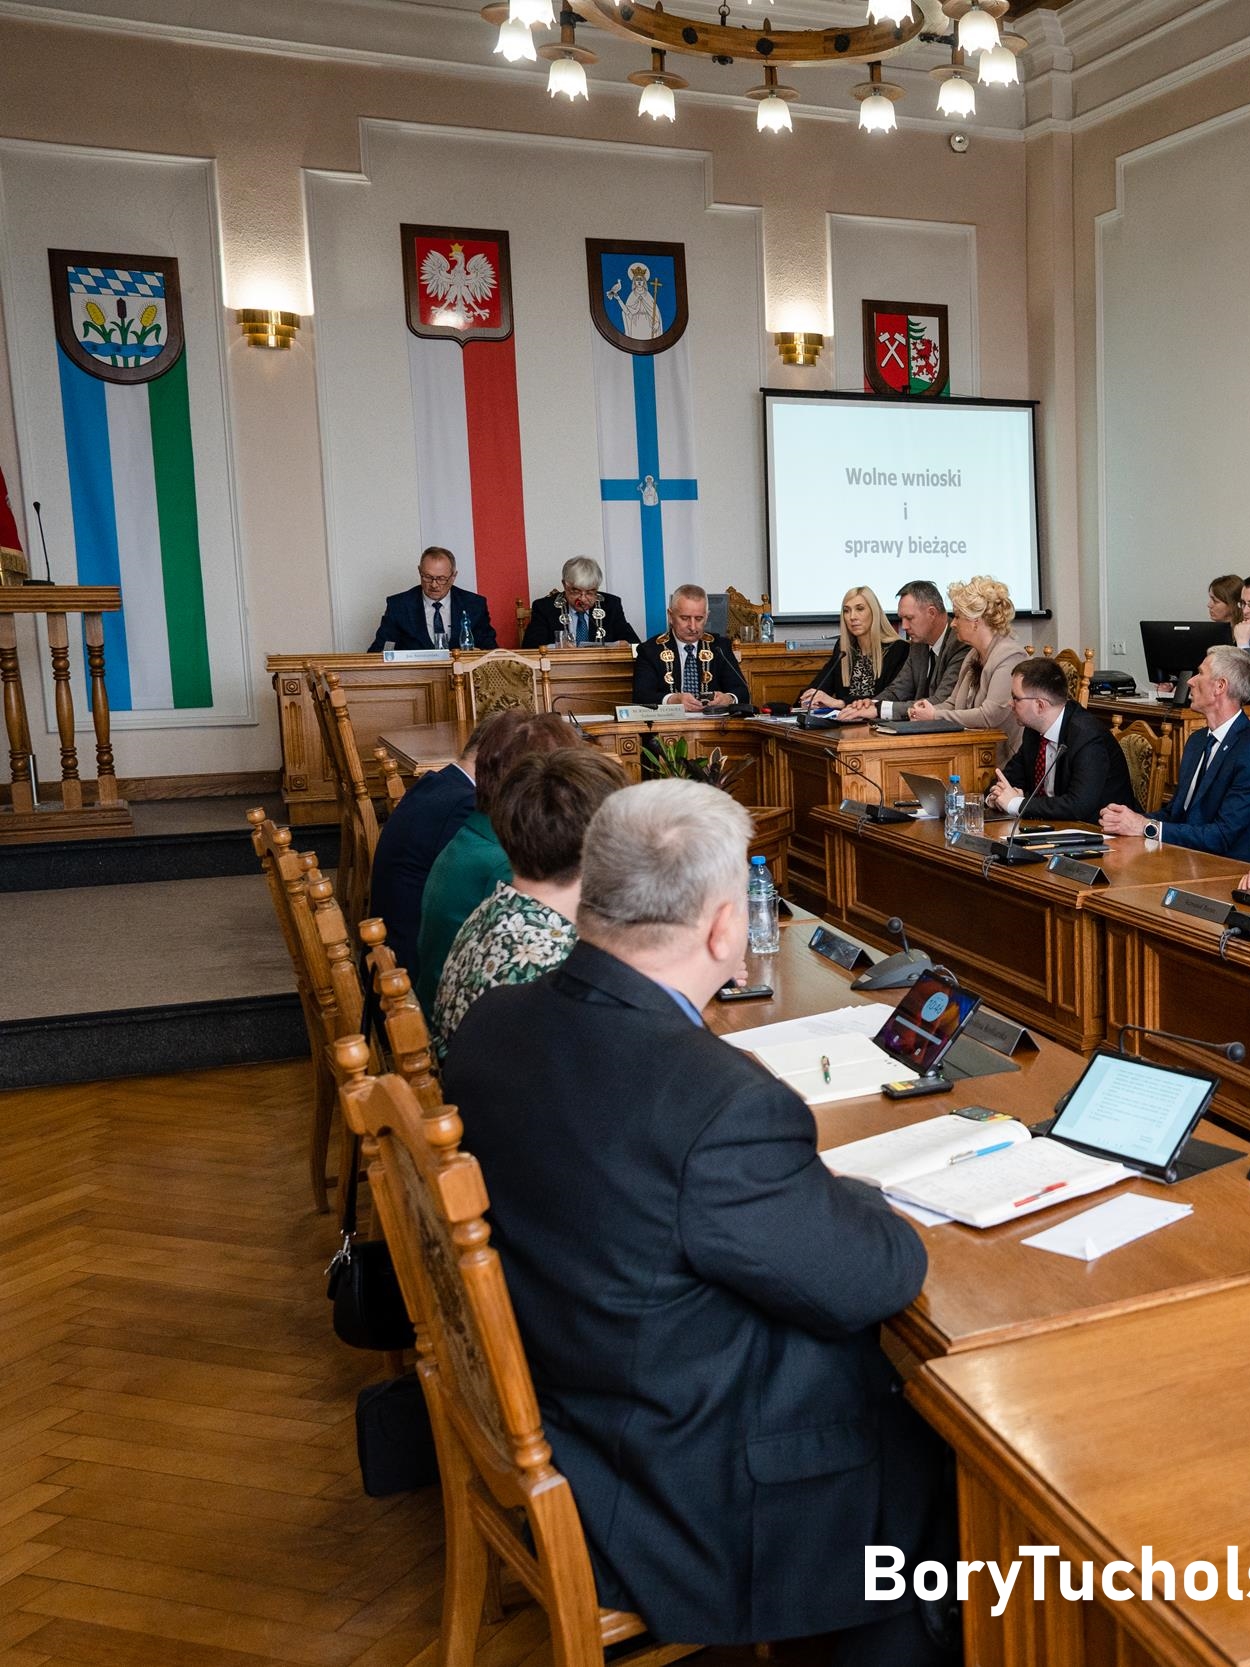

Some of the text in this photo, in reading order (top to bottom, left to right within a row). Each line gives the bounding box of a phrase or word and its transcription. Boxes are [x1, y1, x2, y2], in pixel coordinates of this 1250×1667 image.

[845, 466, 962, 487] Wolne wnioski
[903, 501, 908, 520] i
[844, 535, 968, 558] sprawy bieżące
